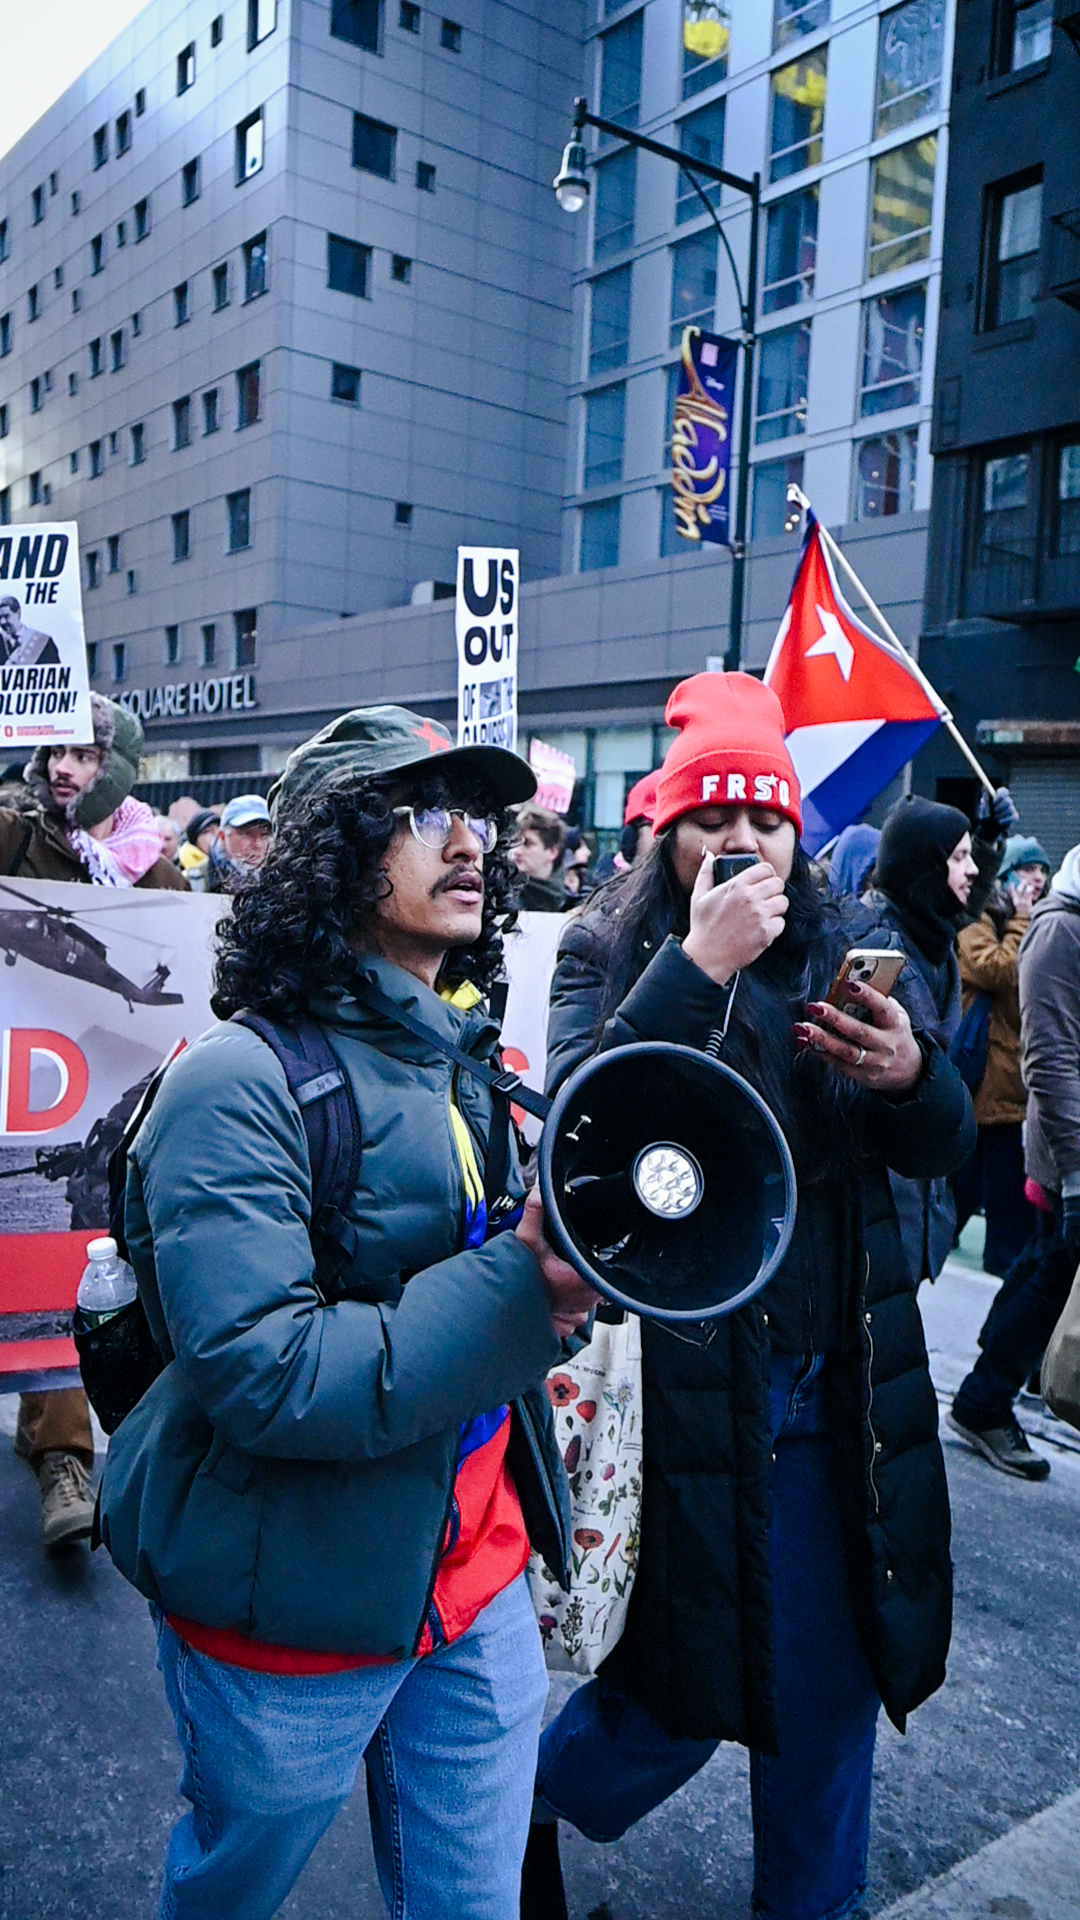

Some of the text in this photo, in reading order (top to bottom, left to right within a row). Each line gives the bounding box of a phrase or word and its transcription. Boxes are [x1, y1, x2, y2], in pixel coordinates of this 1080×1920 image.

[25, 582, 59, 604] THE
[463, 558, 514, 617] US
[464, 623, 514, 666] OUT
[120, 672, 256, 720] SQUARE HOTEL
[463, 683, 477, 722] OF
[702, 772, 790, 807] FRSO
[4, 1028, 88, 1134] D
